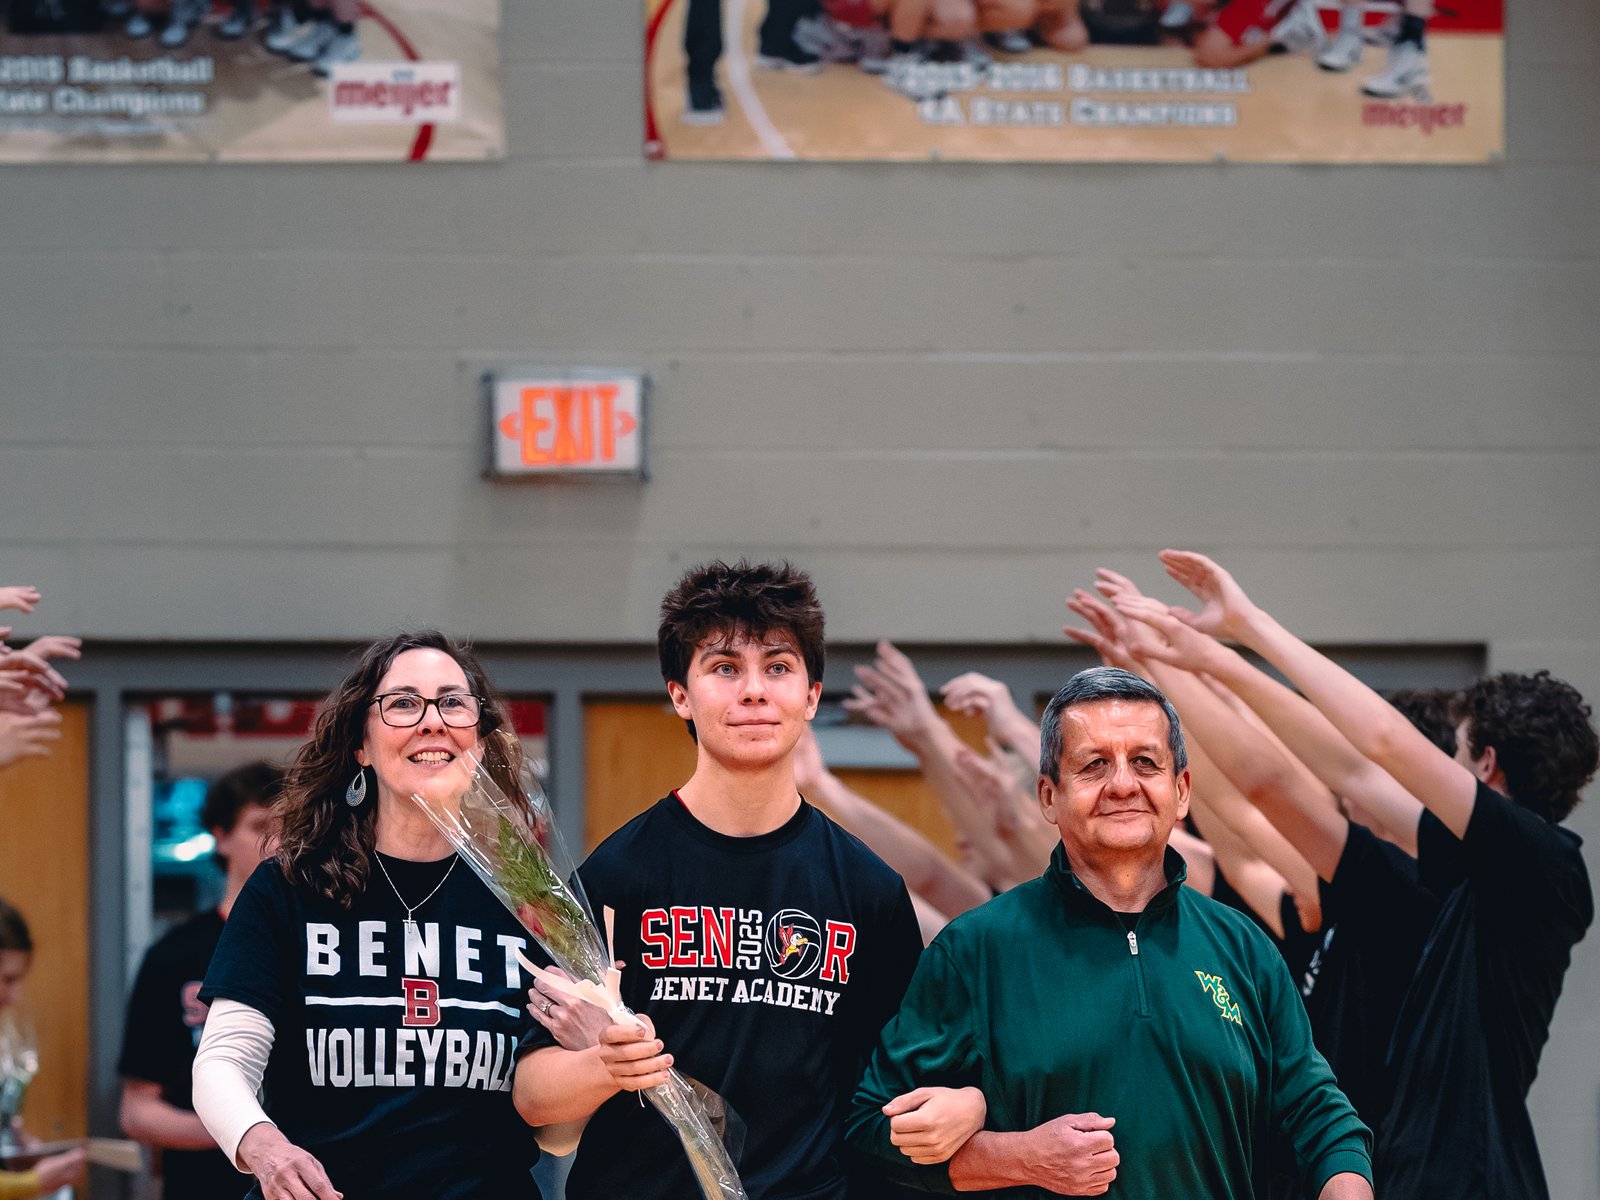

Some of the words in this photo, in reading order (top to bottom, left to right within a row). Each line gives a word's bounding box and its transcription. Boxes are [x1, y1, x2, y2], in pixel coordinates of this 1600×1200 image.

[335, 70, 451, 116] meijer
[1361, 102, 1467, 136] meijer
[521, 384, 620, 467] EXIT
[306, 920, 527, 989] BENET
[736, 908, 763, 970] 2025
[401, 977, 442, 1027] B
[650, 976, 729, 1002] BENET
[731, 978, 841, 1016] ACADEMY
